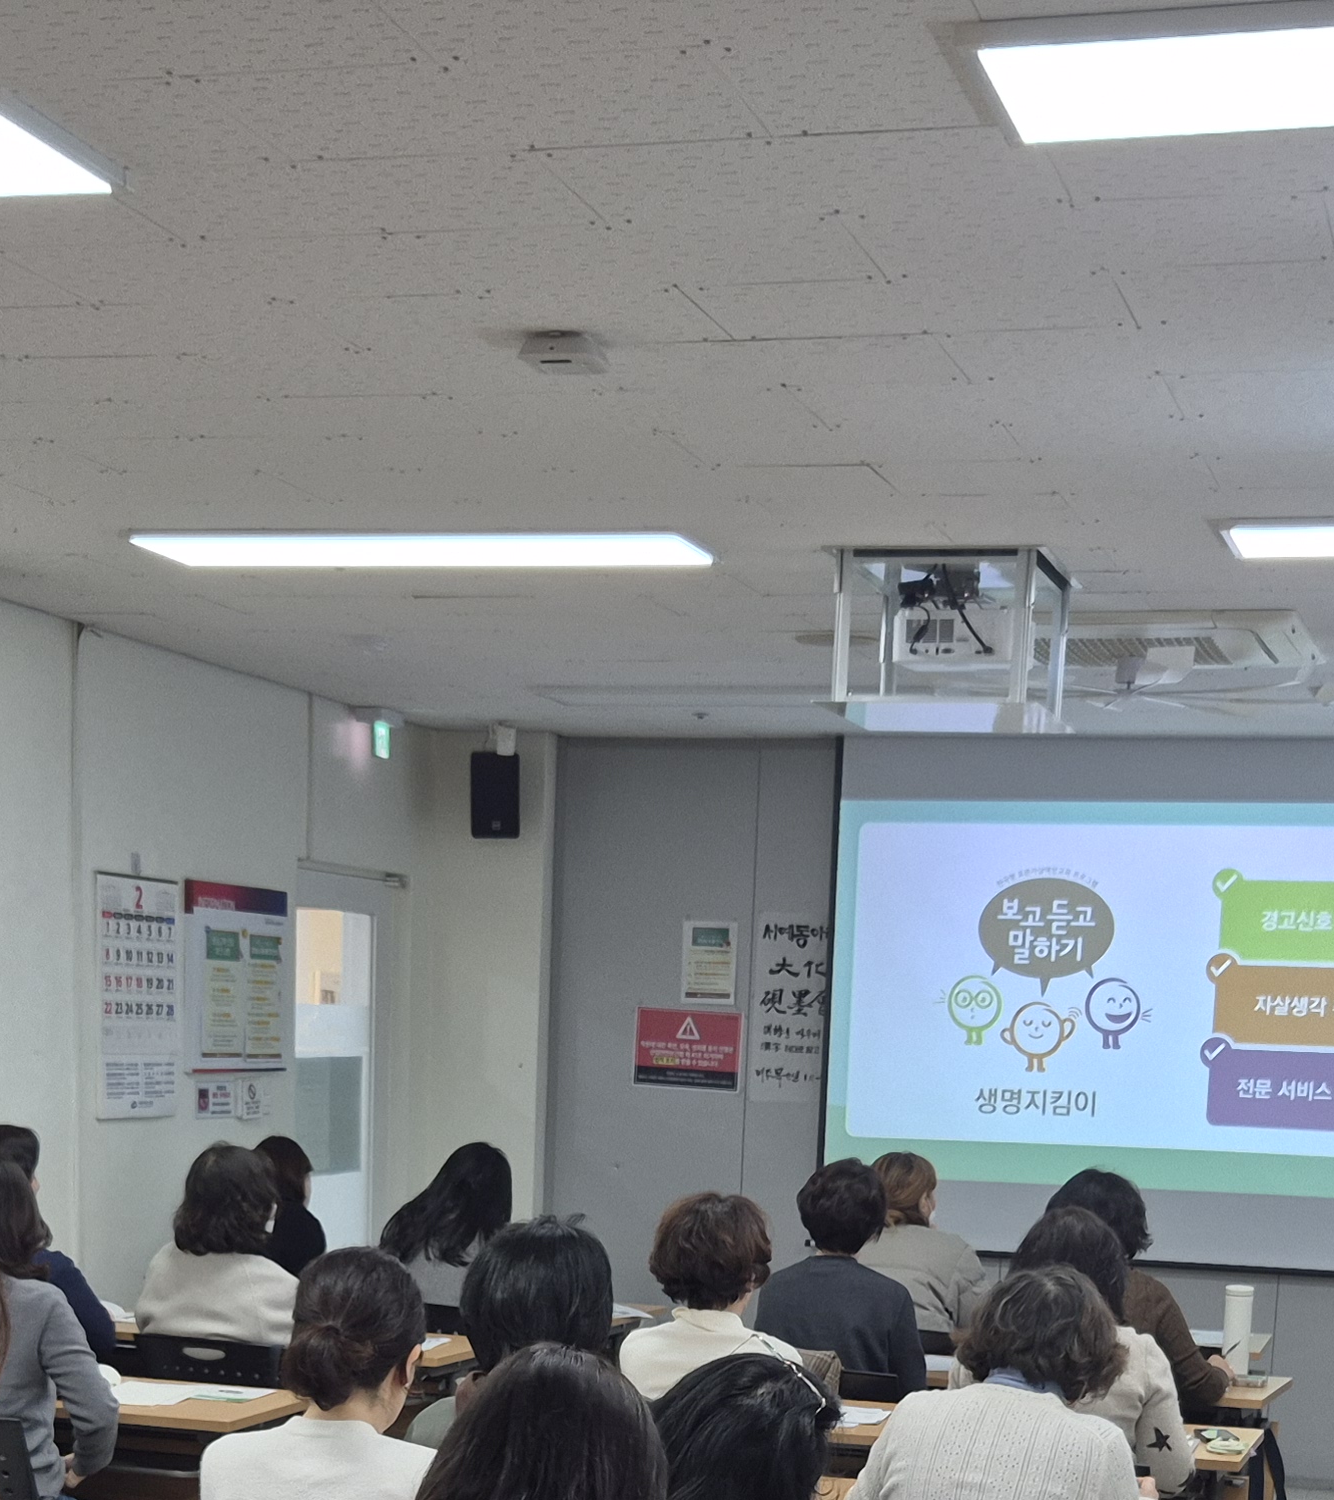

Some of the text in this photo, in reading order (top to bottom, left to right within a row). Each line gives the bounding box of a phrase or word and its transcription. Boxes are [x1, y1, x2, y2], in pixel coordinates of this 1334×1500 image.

[135, 886, 143, 909] 2
[1261, 911, 1333, 932] 경고신호
[763, 923, 828, 949] 서예동아
[1008, 928, 1083, 964] 말하기
[1254, 995, 1327, 1017] 자살생각
[1236, 1078, 1272, 1099] 전문
[1277, 1079, 1332, 1101] 서비스
[974, 1087, 1097, 1118] 생명지킴이
